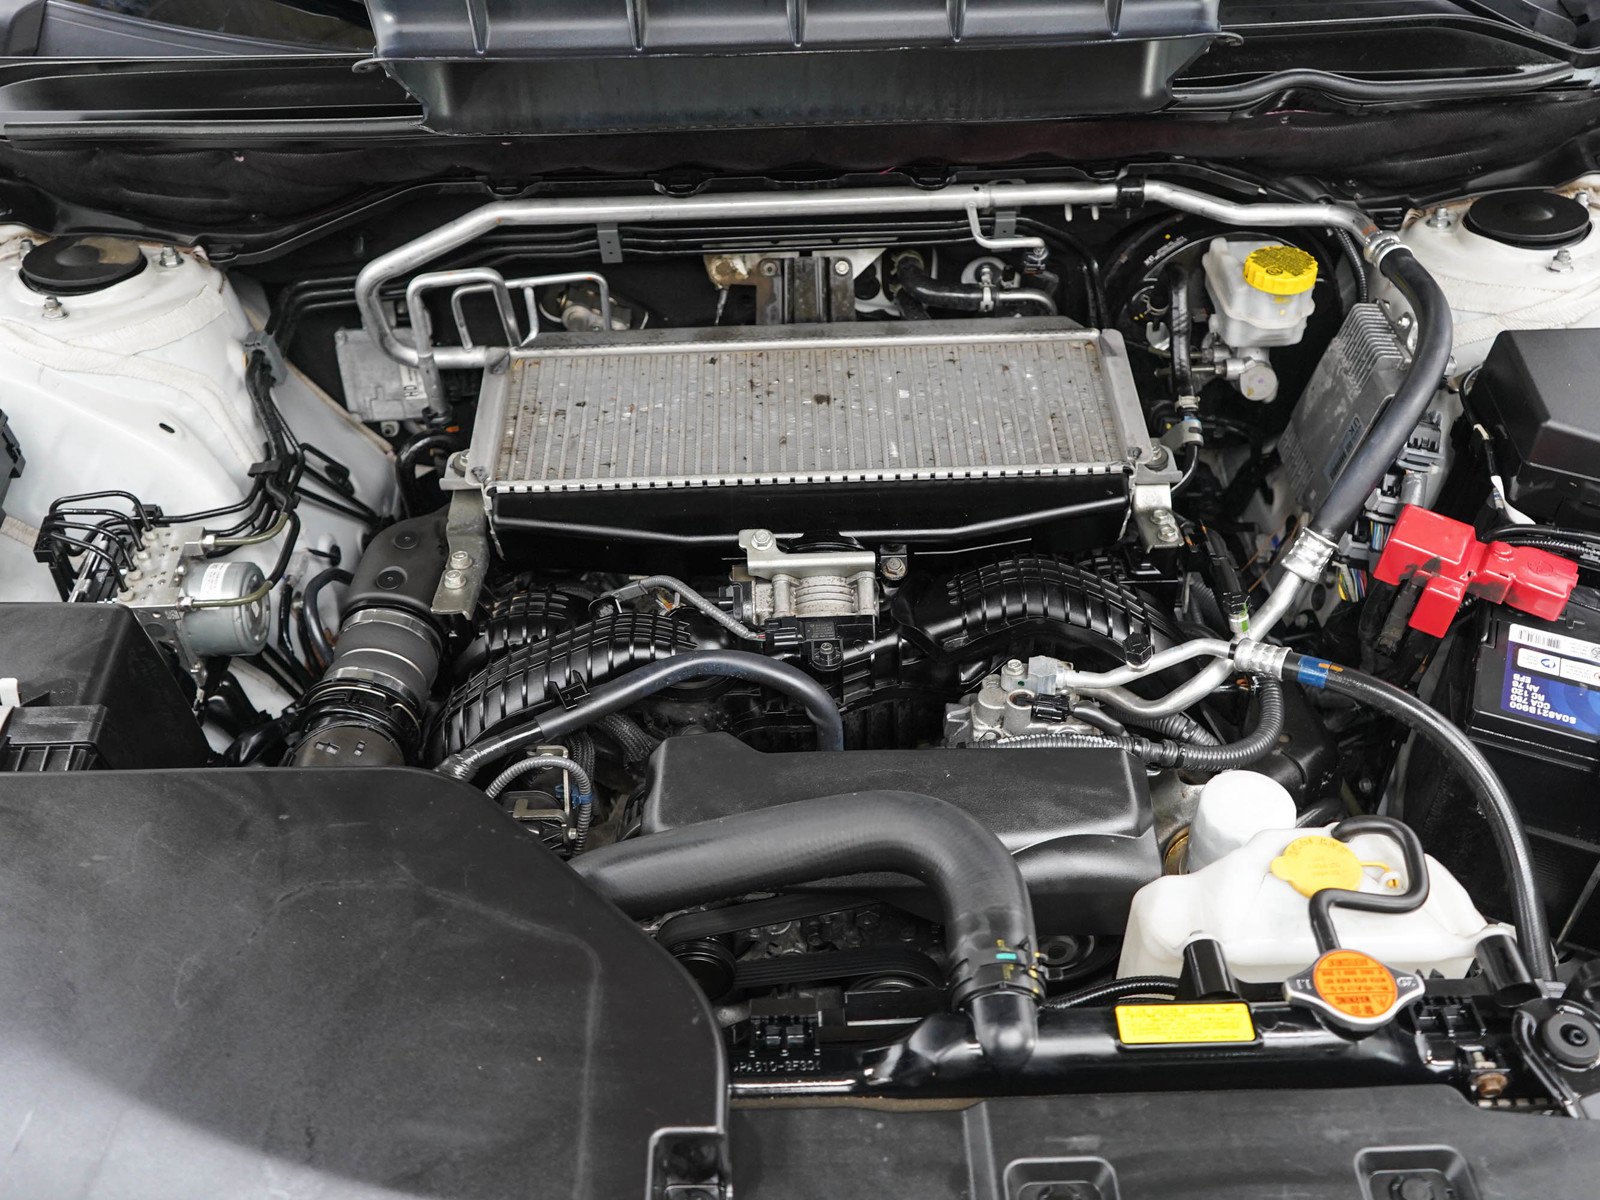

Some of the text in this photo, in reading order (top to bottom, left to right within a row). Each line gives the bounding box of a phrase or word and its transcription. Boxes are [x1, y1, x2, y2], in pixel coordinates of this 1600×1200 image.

[1526, 684, 1540, 692] Ah
[1511, 687, 1545, 701] RC 120
[1530, 699, 1551, 709] CCA
